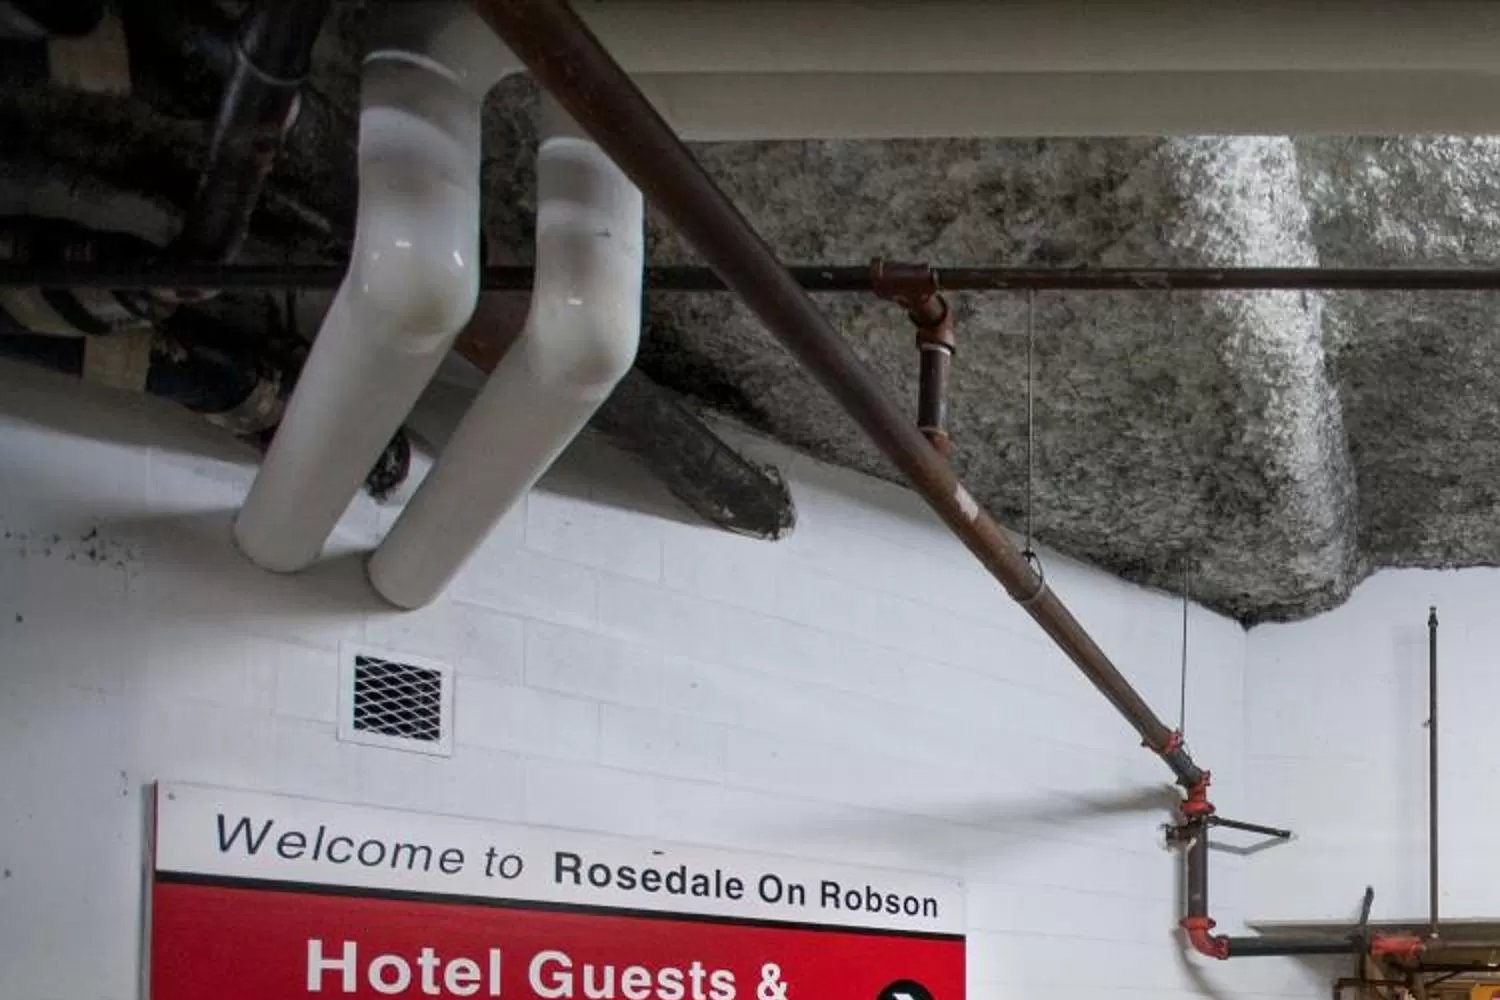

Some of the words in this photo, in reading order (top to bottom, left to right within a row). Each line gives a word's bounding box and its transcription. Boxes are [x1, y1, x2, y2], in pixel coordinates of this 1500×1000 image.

[216, 813, 465, 874] Welcome
[484, 846, 524, 879] to
[554, 851, 744, 901] Rosedale
[758, 874, 806, 906] On
[820, 880, 940, 918] Robson
[306, 938, 501, 997] Hotel
